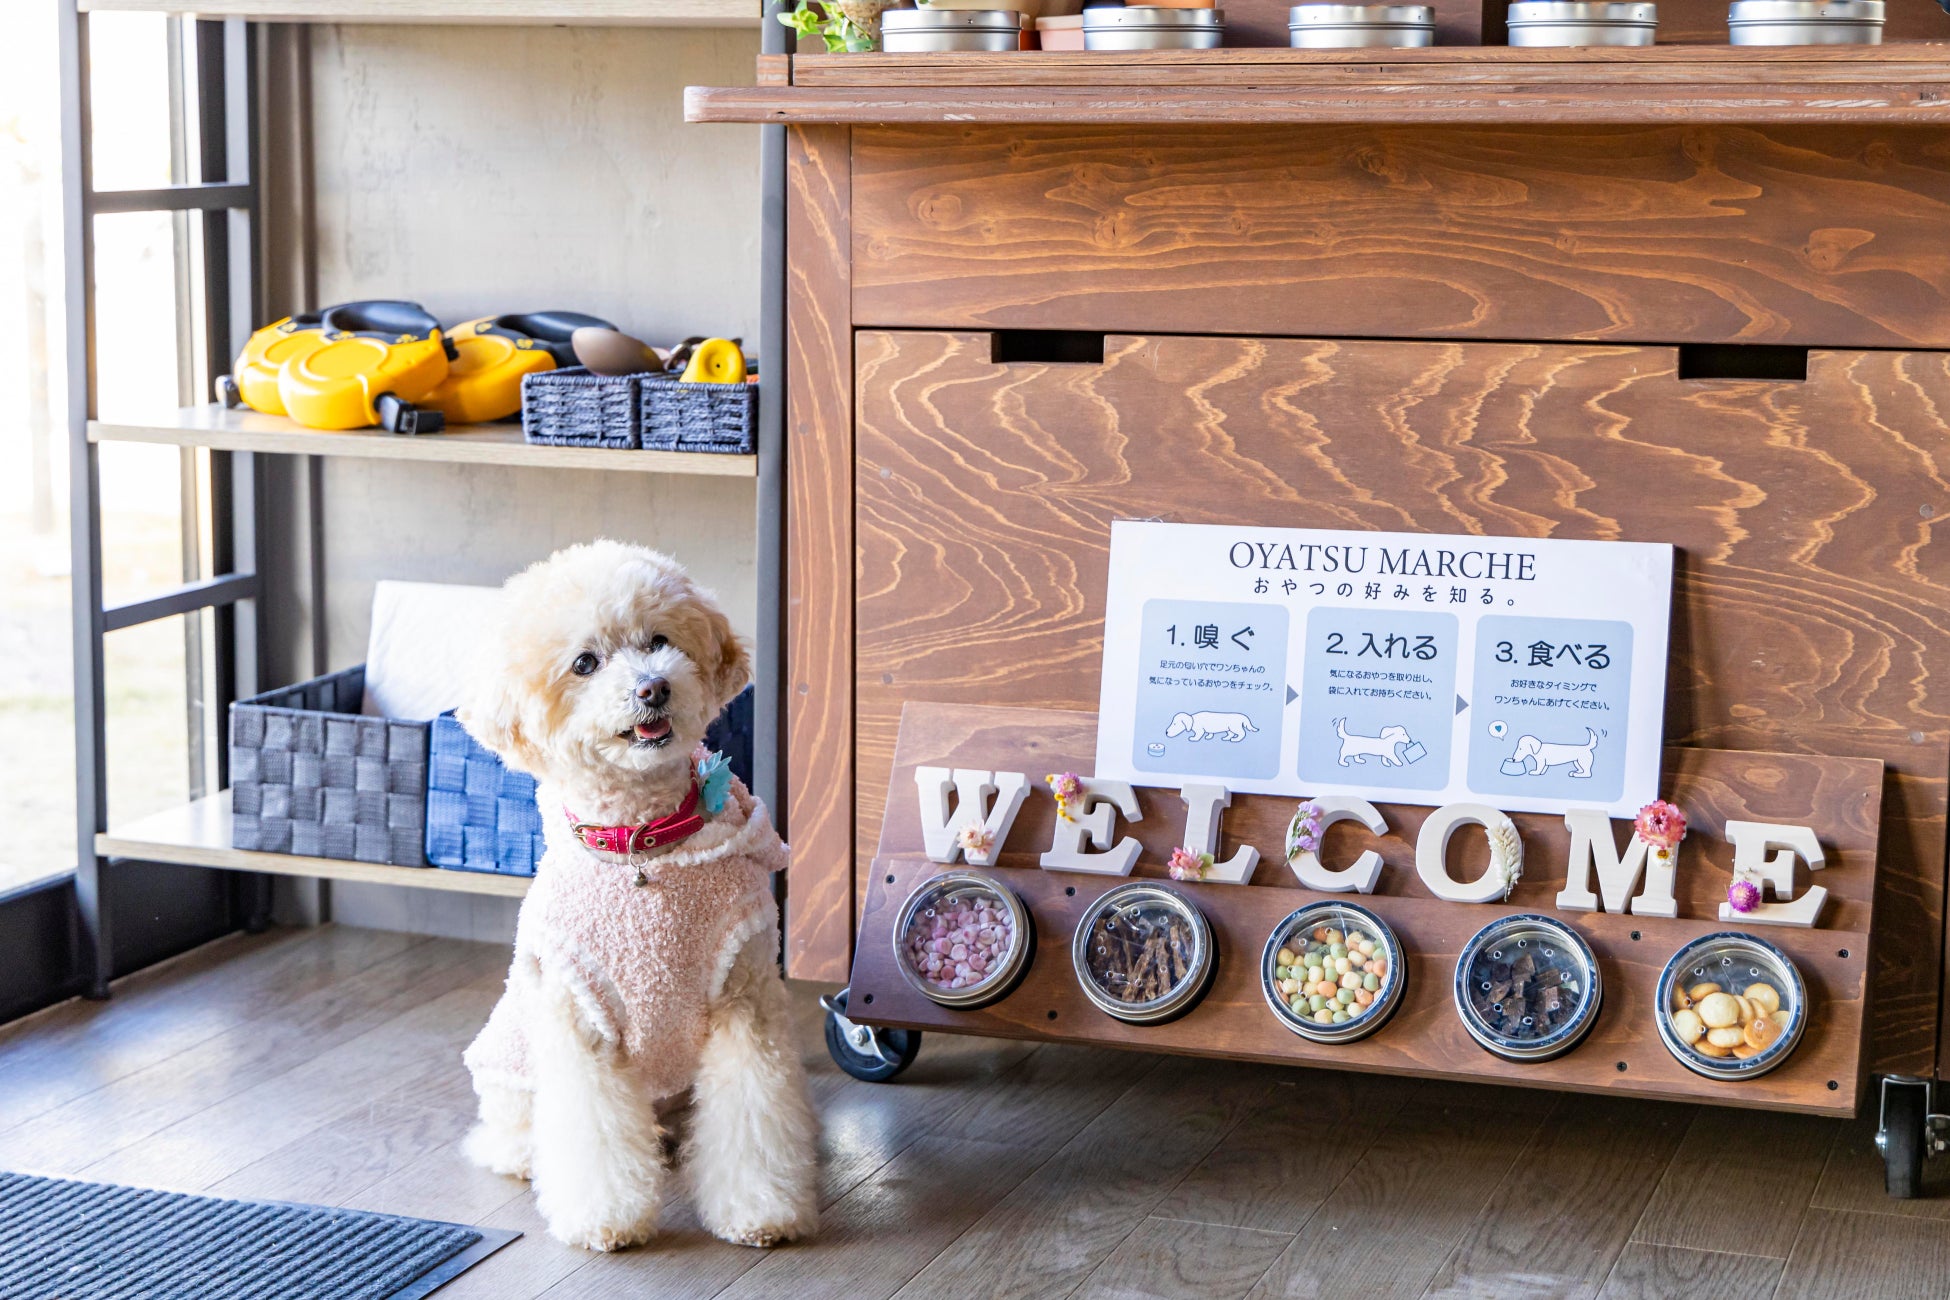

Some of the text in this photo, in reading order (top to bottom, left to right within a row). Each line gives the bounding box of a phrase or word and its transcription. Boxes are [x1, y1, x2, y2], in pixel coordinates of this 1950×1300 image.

[1229, 541, 1537, 581] OYATSU MARCHE
[1253, 576, 1515, 607] おやつの好みを知る。
[1357, 632, 1438, 661] 入れる
[1527, 640, 1611, 670] 食べる
[1149, 675, 1273, 692] 気になっているおやつをチェック。
[1329, 668, 1433, 684] 気になるおやつを取り出し、
[1510, 679, 1598, 693] お好きなタイミングで
[1328, 685, 1432, 701] 袋に入れてお持ちください。
[1494, 694, 1611, 711] ワンちゃんにあげてください。
[914, 766, 1830, 929] WELCOME
